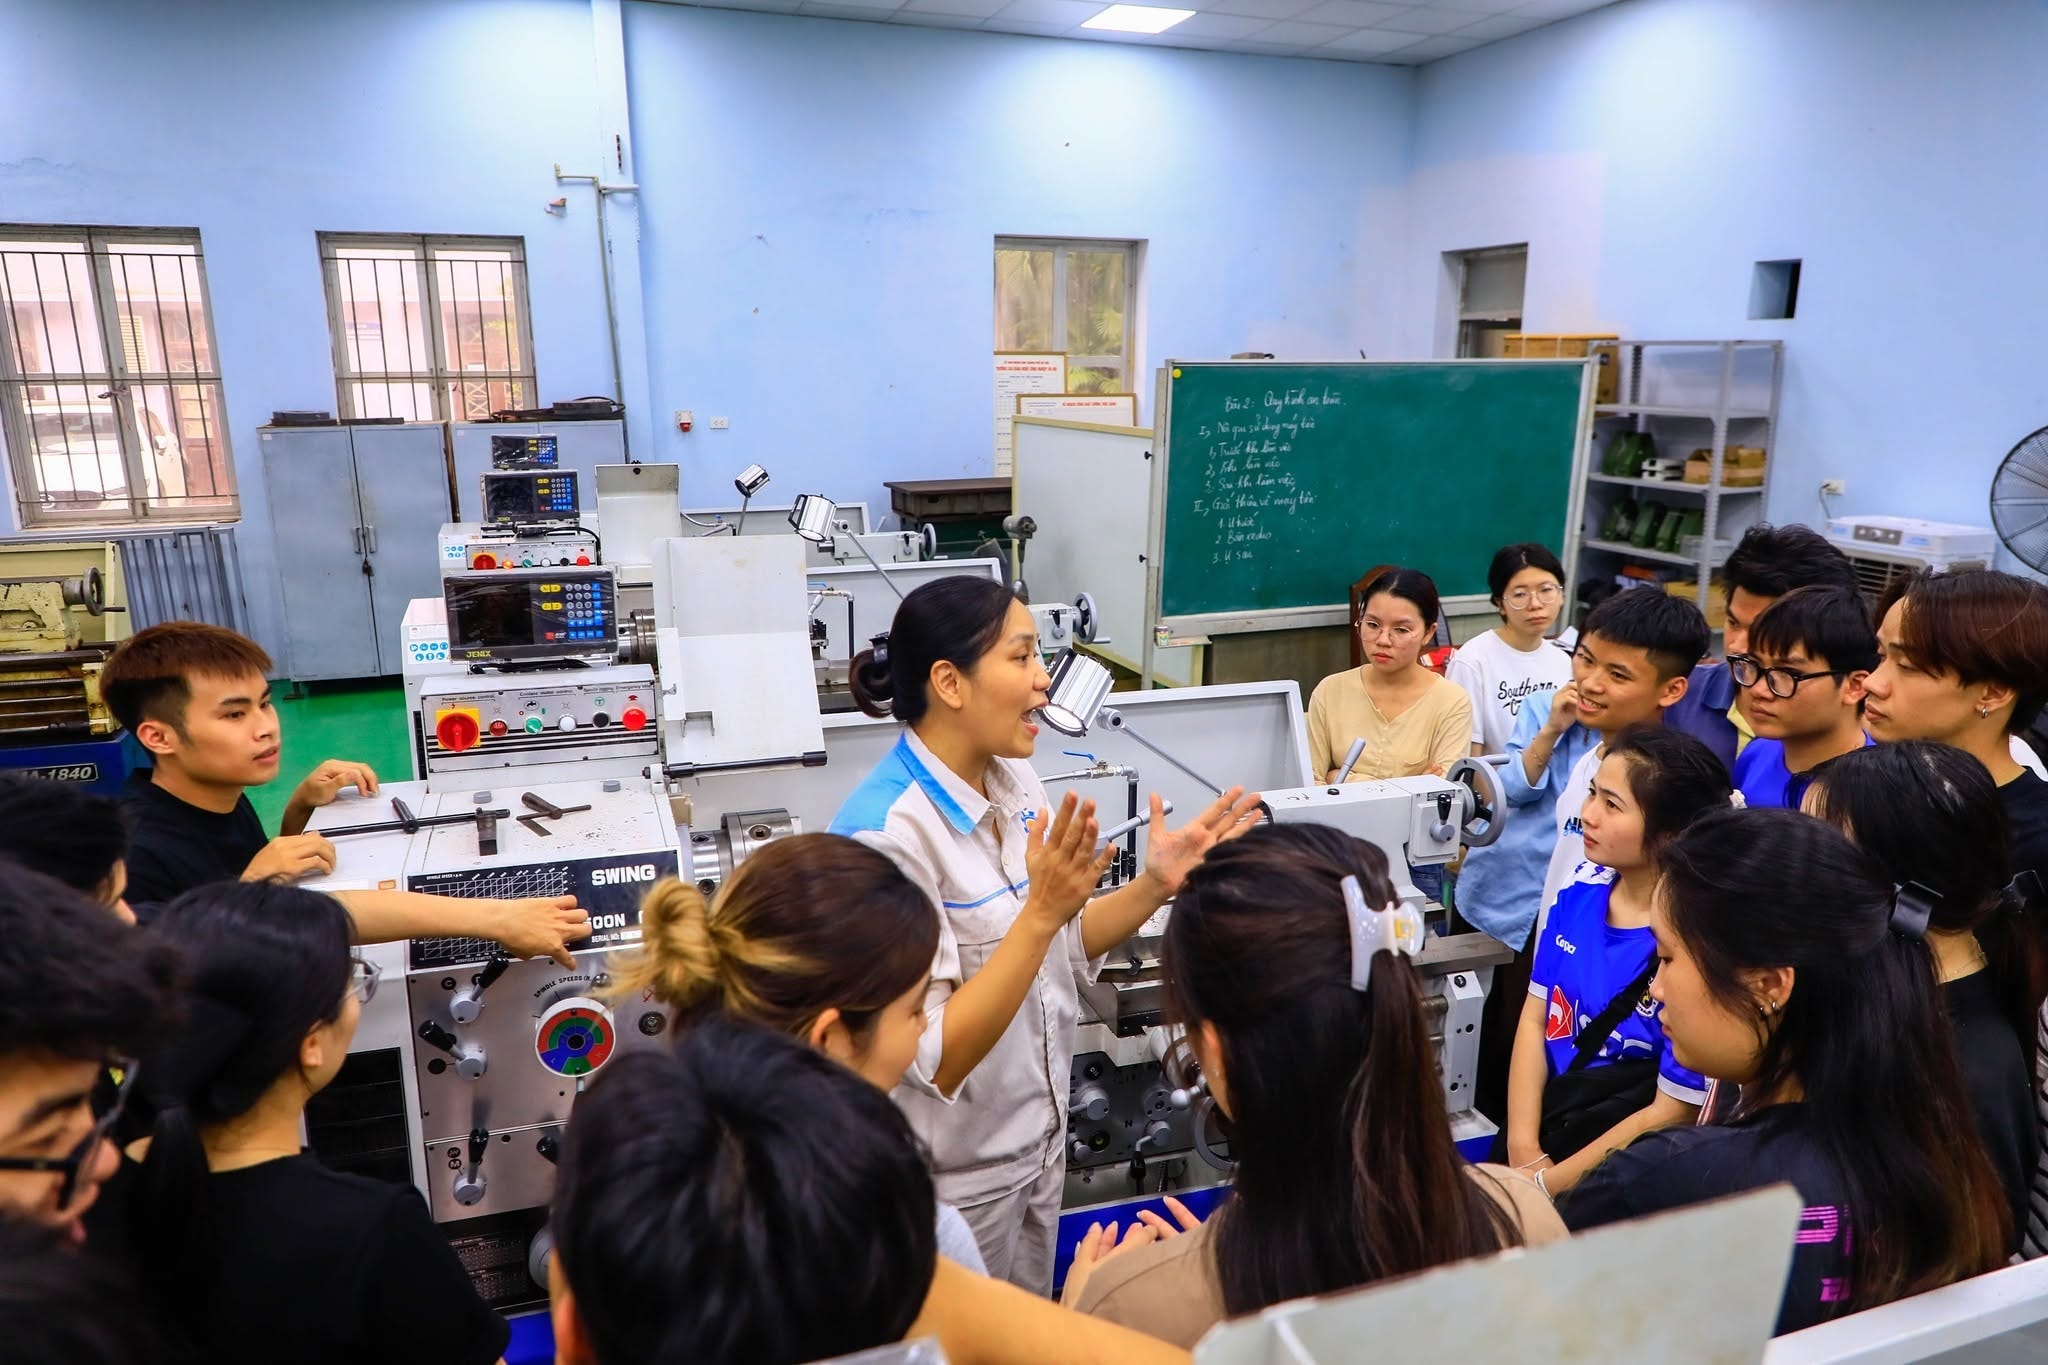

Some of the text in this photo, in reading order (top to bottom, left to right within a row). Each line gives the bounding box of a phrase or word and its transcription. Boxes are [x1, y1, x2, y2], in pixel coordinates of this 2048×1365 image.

[466, 650, 492, 658] JENIX
[591, 864, 656, 886] SWING
[534, 980, 556, 998] SPINDLE
[558, 975, 583, 984] SPEEDS
